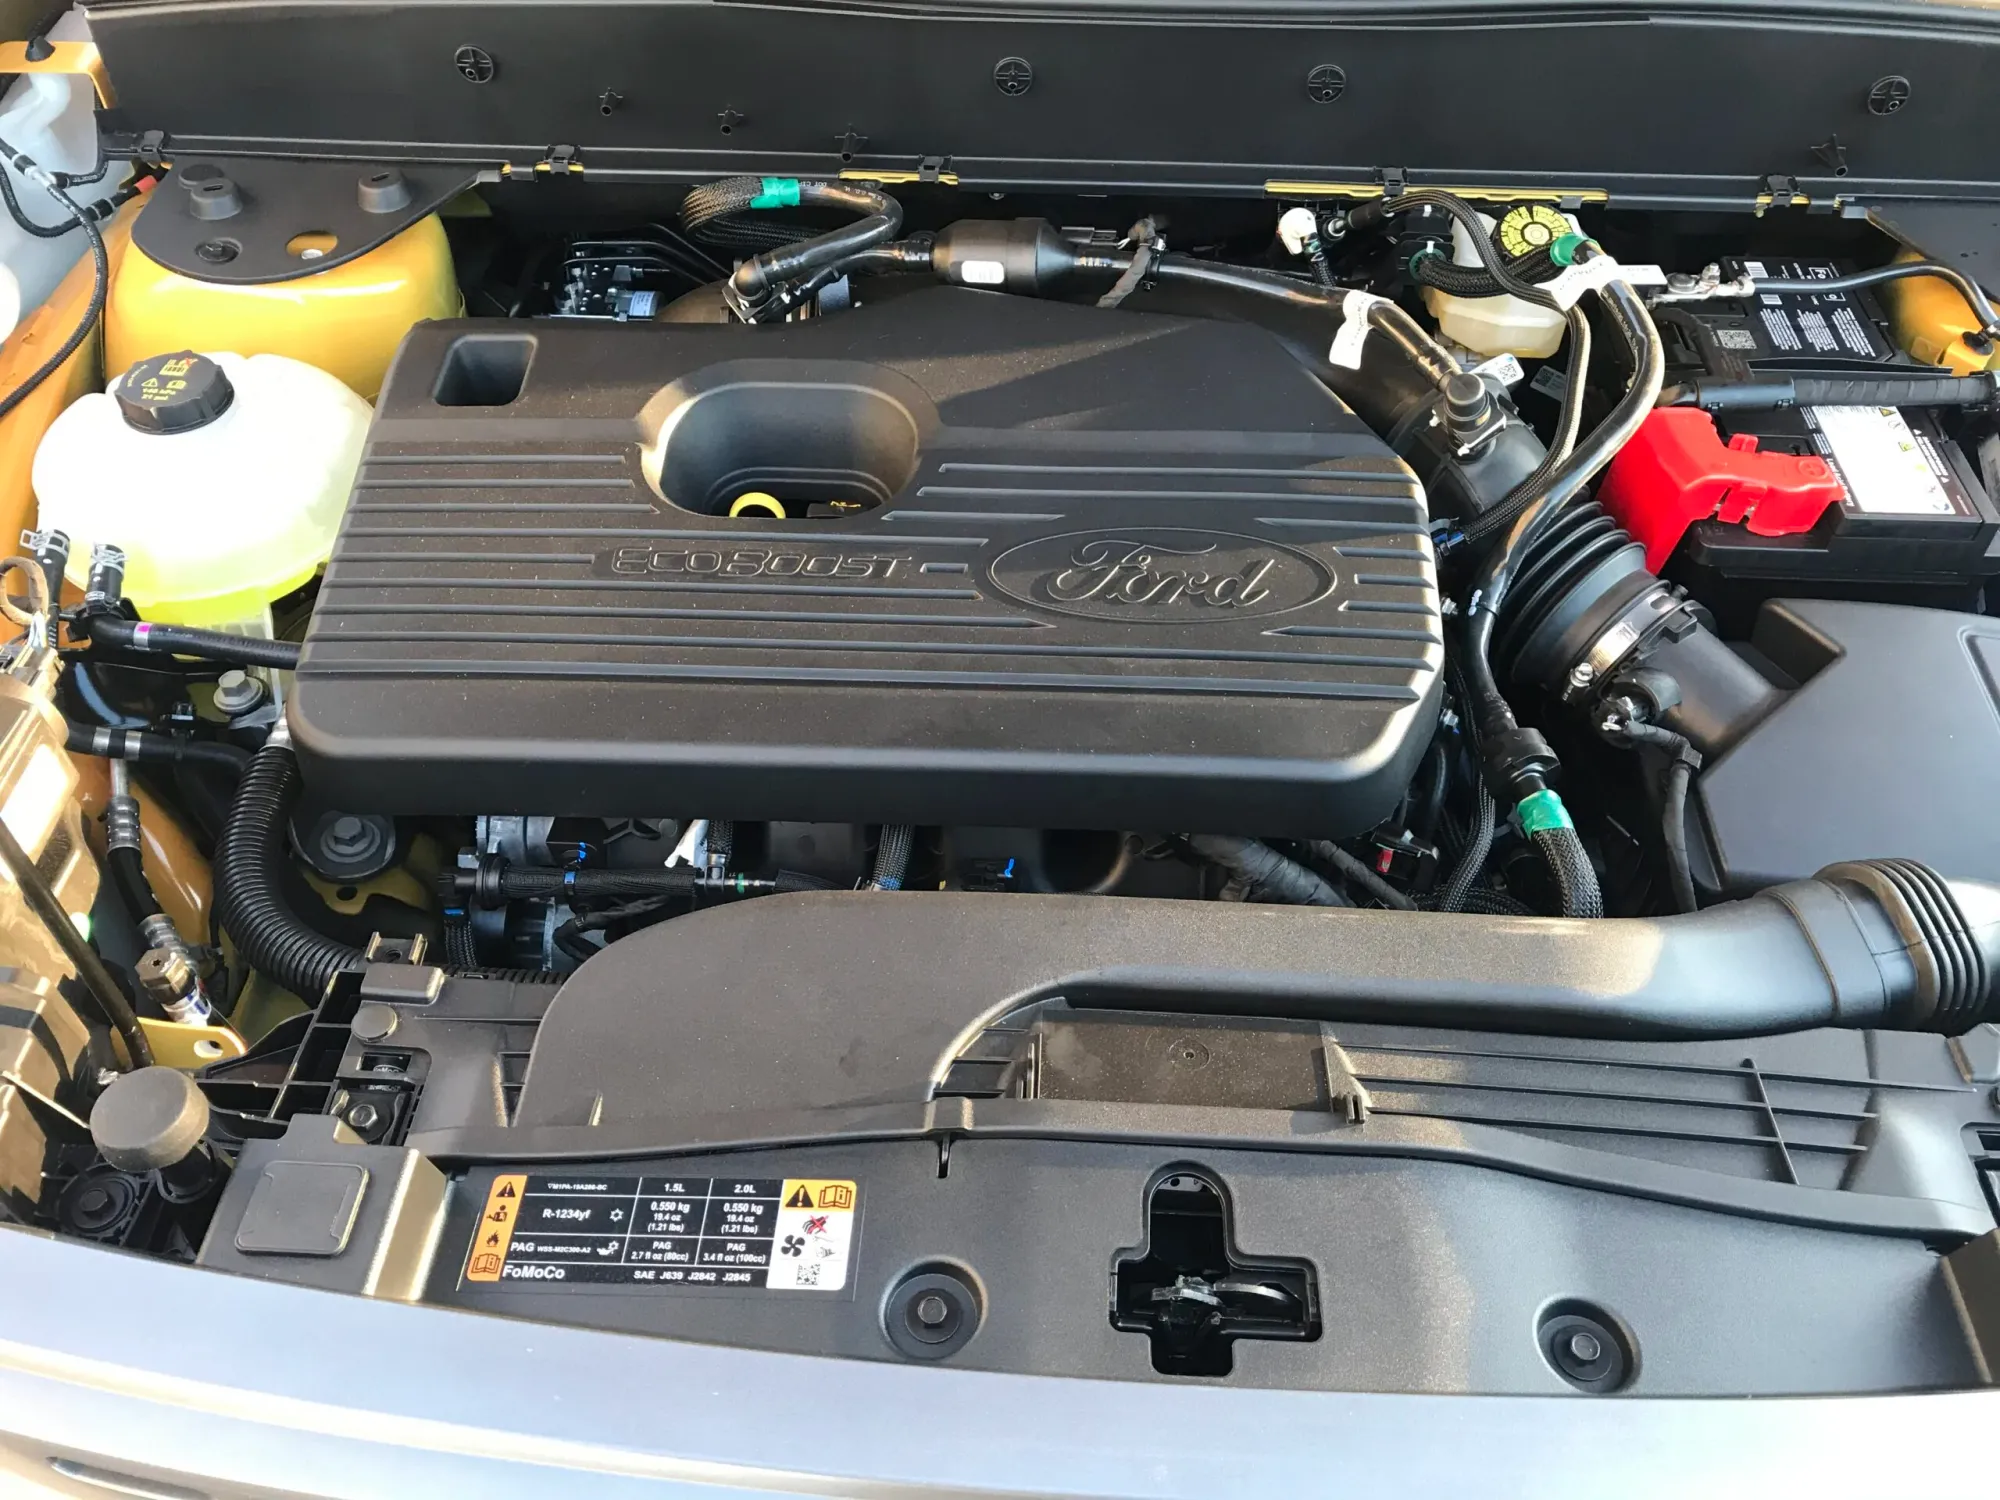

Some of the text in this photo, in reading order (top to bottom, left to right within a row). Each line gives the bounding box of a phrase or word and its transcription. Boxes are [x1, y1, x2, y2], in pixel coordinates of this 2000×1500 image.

[1046, 539, 1275, 607] Ford
[664, 1183, 685, 1193] 1.5L
[734, 1184, 756, 1194] 2.0L
[650, 1201, 690, 1213] 0.550 kg
[723, 1202, 764, 1215] 0.550 kg
[542, 1208, 592, 1222] R-1234yf
[653, 1213, 670, 1221] 19.4
[726, 1214, 755, 1223] 19.4 oz
[647, 1223, 685, 1233] (1.21 lbs)
[720, 1224, 758, 1234] (1.21 lbs)
[510, 1241, 535, 1252] PAG
[652, 1241, 672, 1250] PAG
[726, 1242, 746, 1251] PAG
[631, 1251, 643, 1260] 2.7
[652, 1253, 662, 1261] oz
[703, 1253, 716, 1262] 3.4
[502, 1264, 566, 1279] FoMoCo
[633, 1270, 751, 1282] SAE J639 J2842 J2845
